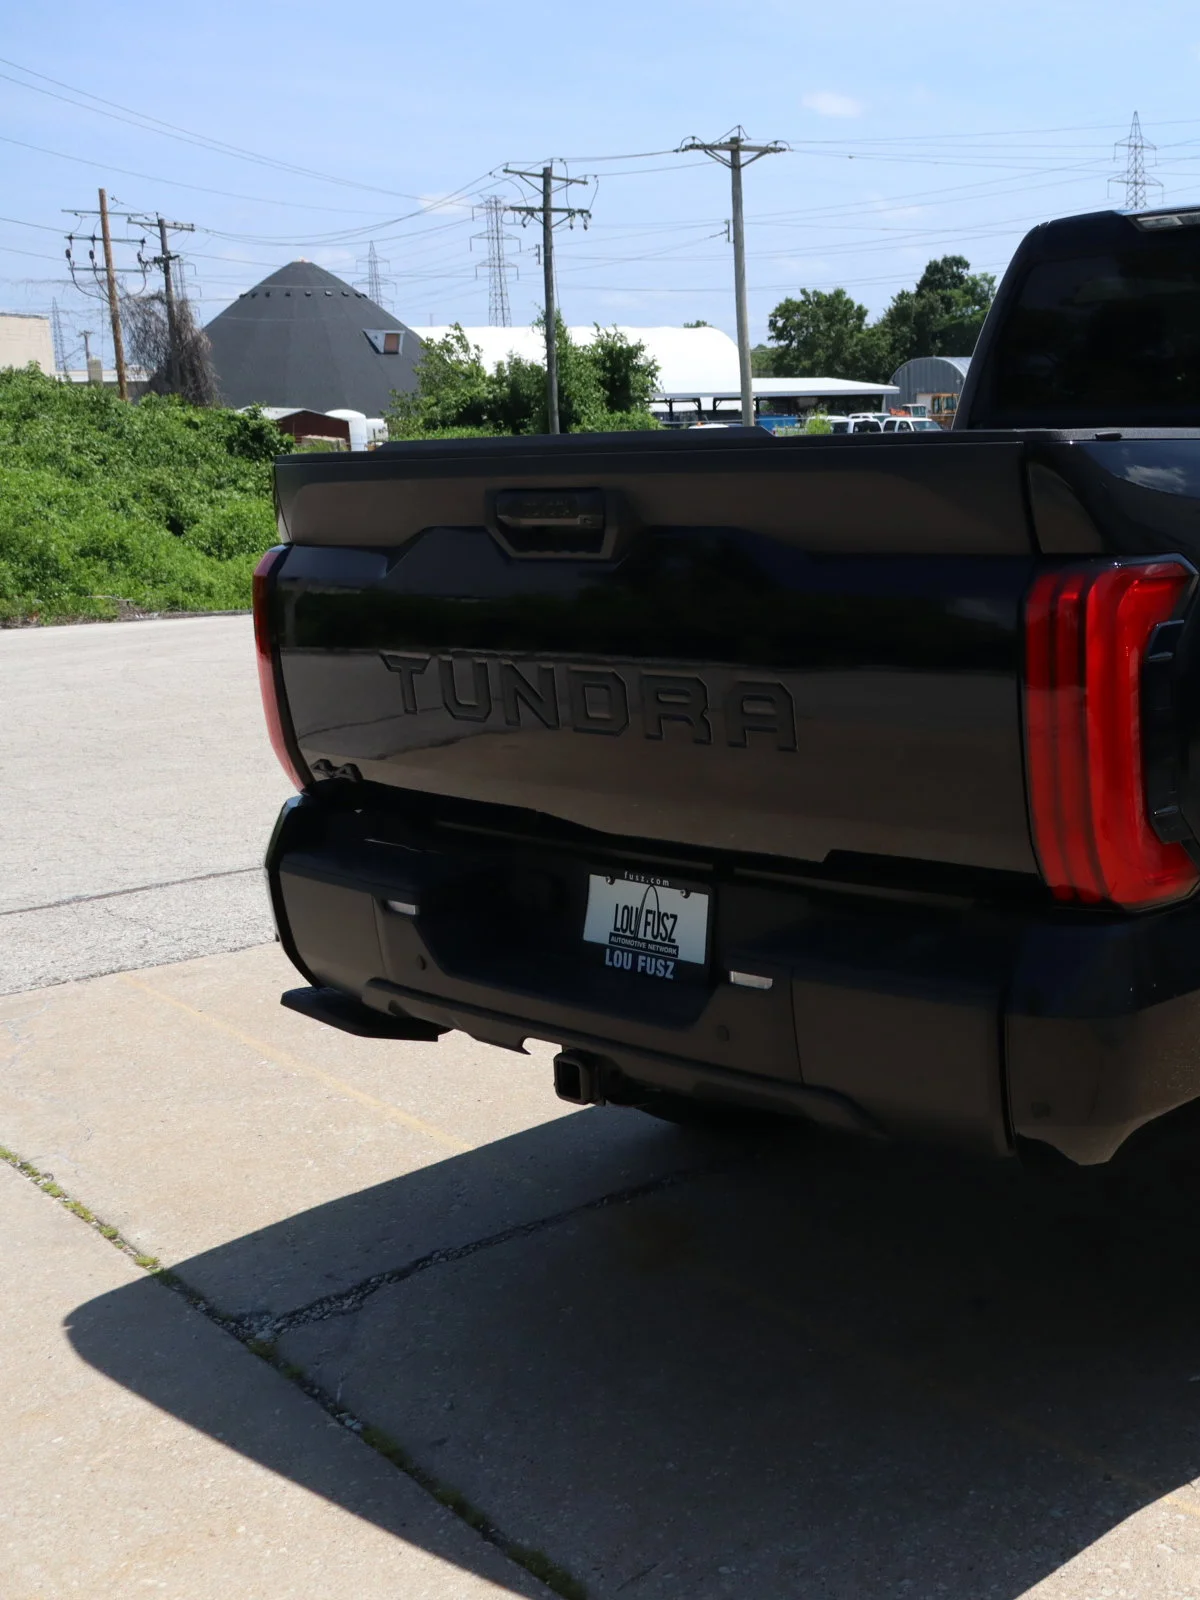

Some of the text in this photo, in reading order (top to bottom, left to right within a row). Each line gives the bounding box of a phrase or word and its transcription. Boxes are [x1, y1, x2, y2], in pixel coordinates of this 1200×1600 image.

[378, 649, 799, 752] TUNDRA
[624, 870, 670, 886] fusz.com
[613, 903, 678, 943] LOU FUSZ
[610, 936, 677, 956] AUTOMOTIVE NETWORK
[605, 948, 675, 980] LOU FUSZ
